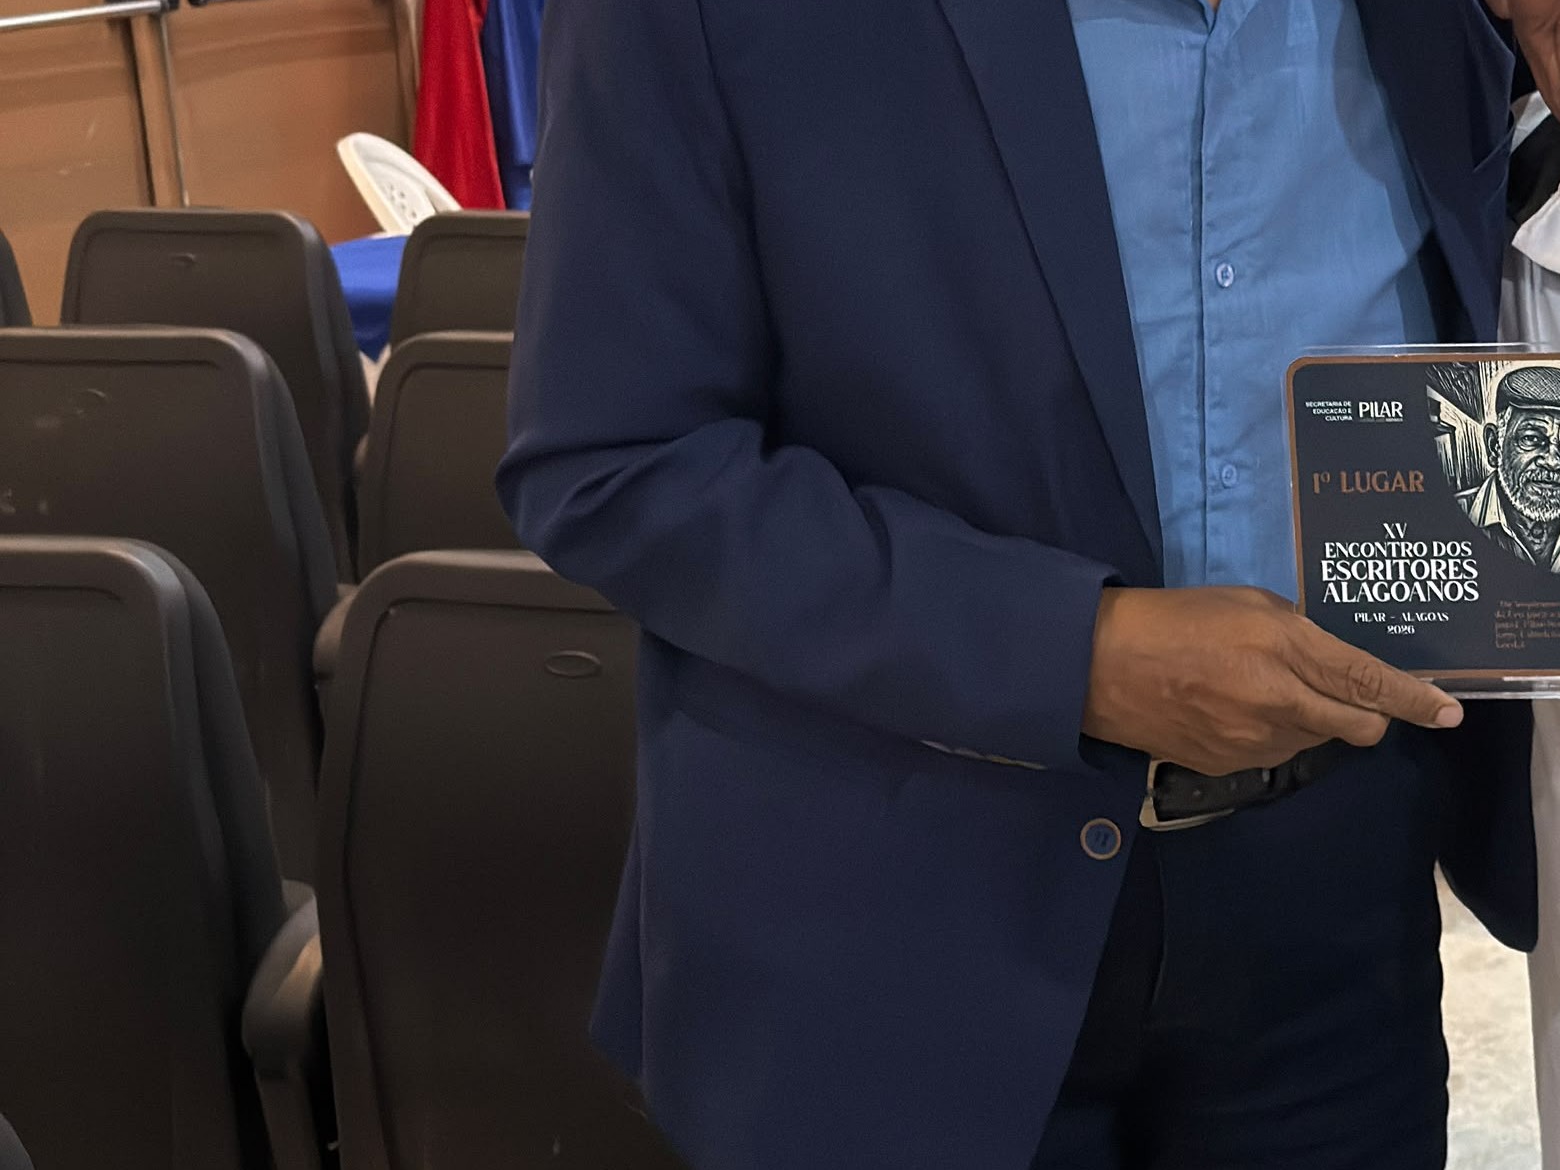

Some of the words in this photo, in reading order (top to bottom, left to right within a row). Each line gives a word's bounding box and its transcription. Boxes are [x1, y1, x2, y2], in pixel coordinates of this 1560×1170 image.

[1359, 401, 1403, 418] PILAR
[1340, 470, 1425, 493] LUGAR
[1383, 522, 1408, 539] XV
[1325, 542, 1428, 558] ENCONTRO
[1432, 541, 1472, 557] DOS
[1321, 559, 1478, 581] ESCRITORES
[1323, 580, 1479, 603] ALAGOANOS
[1354, 612, 1386, 623] PILAR
[1402, 611, 1449, 622] ALAGOAS
